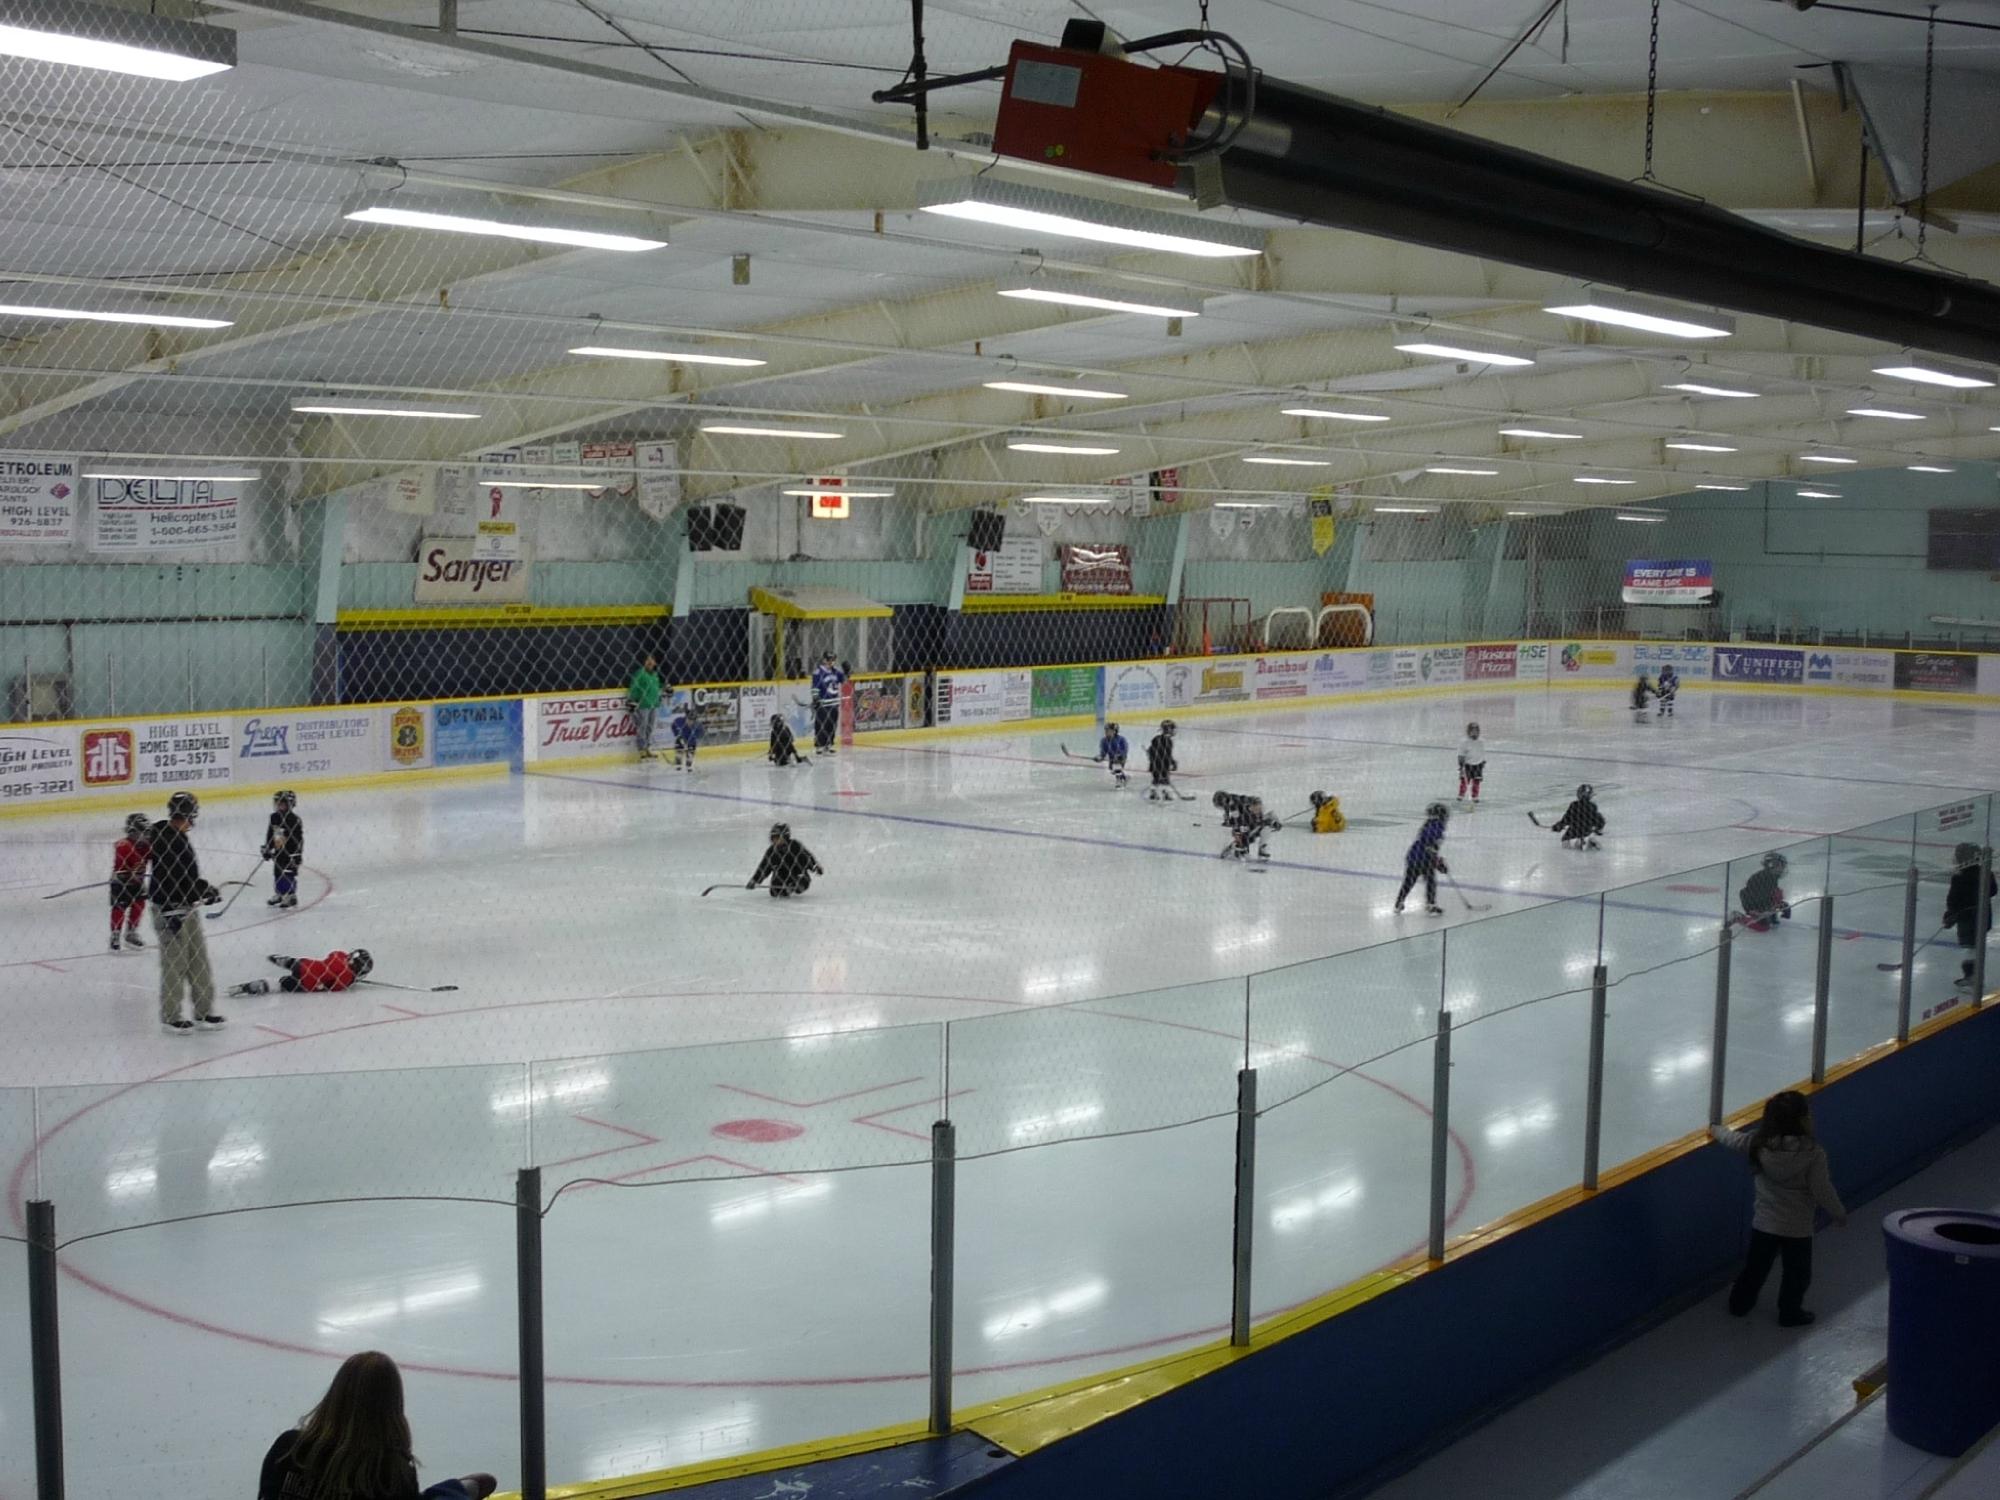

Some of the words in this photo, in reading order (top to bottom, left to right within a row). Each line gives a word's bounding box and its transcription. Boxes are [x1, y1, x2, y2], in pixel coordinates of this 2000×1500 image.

[97, 479, 214, 505] DELTA
[2, 505, 33, 517] HIGH
[37, 506, 71, 517] LEVEL
[150, 511, 217, 524] Helicopters
[1633, 568, 1665, 578] EVERY
[1666, 568, 1684, 577] DAY
[1685, 567, 1696, 577] IS
[1632, 578, 1662, 587] GAME
[1479, 649, 1516, 660] Boston
[1520, 645, 1547, 658] HSE
[1256, 658, 1309, 674] Rainbow
[1480, 662, 1512, 673] Pizza
[1743, 657, 1803, 669] UNIFIED
[1743, 667, 1801, 678] VALVE
[742, 686, 776, 697] RONA
[149, 724, 178, 739] HIGH
[185, 722, 221, 737] LEVEL
[296, 718, 370, 731] DISTRIBUTORS
[542, 717, 590, 747] True
[583, 714, 638, 742] Valu
[139, 740, 169, 754] HOME
[173, 736, 230, 752] HARDWARE
[32, 748, 72, 760] LEVEL
[154, 751, 216, 768] 926-3575
